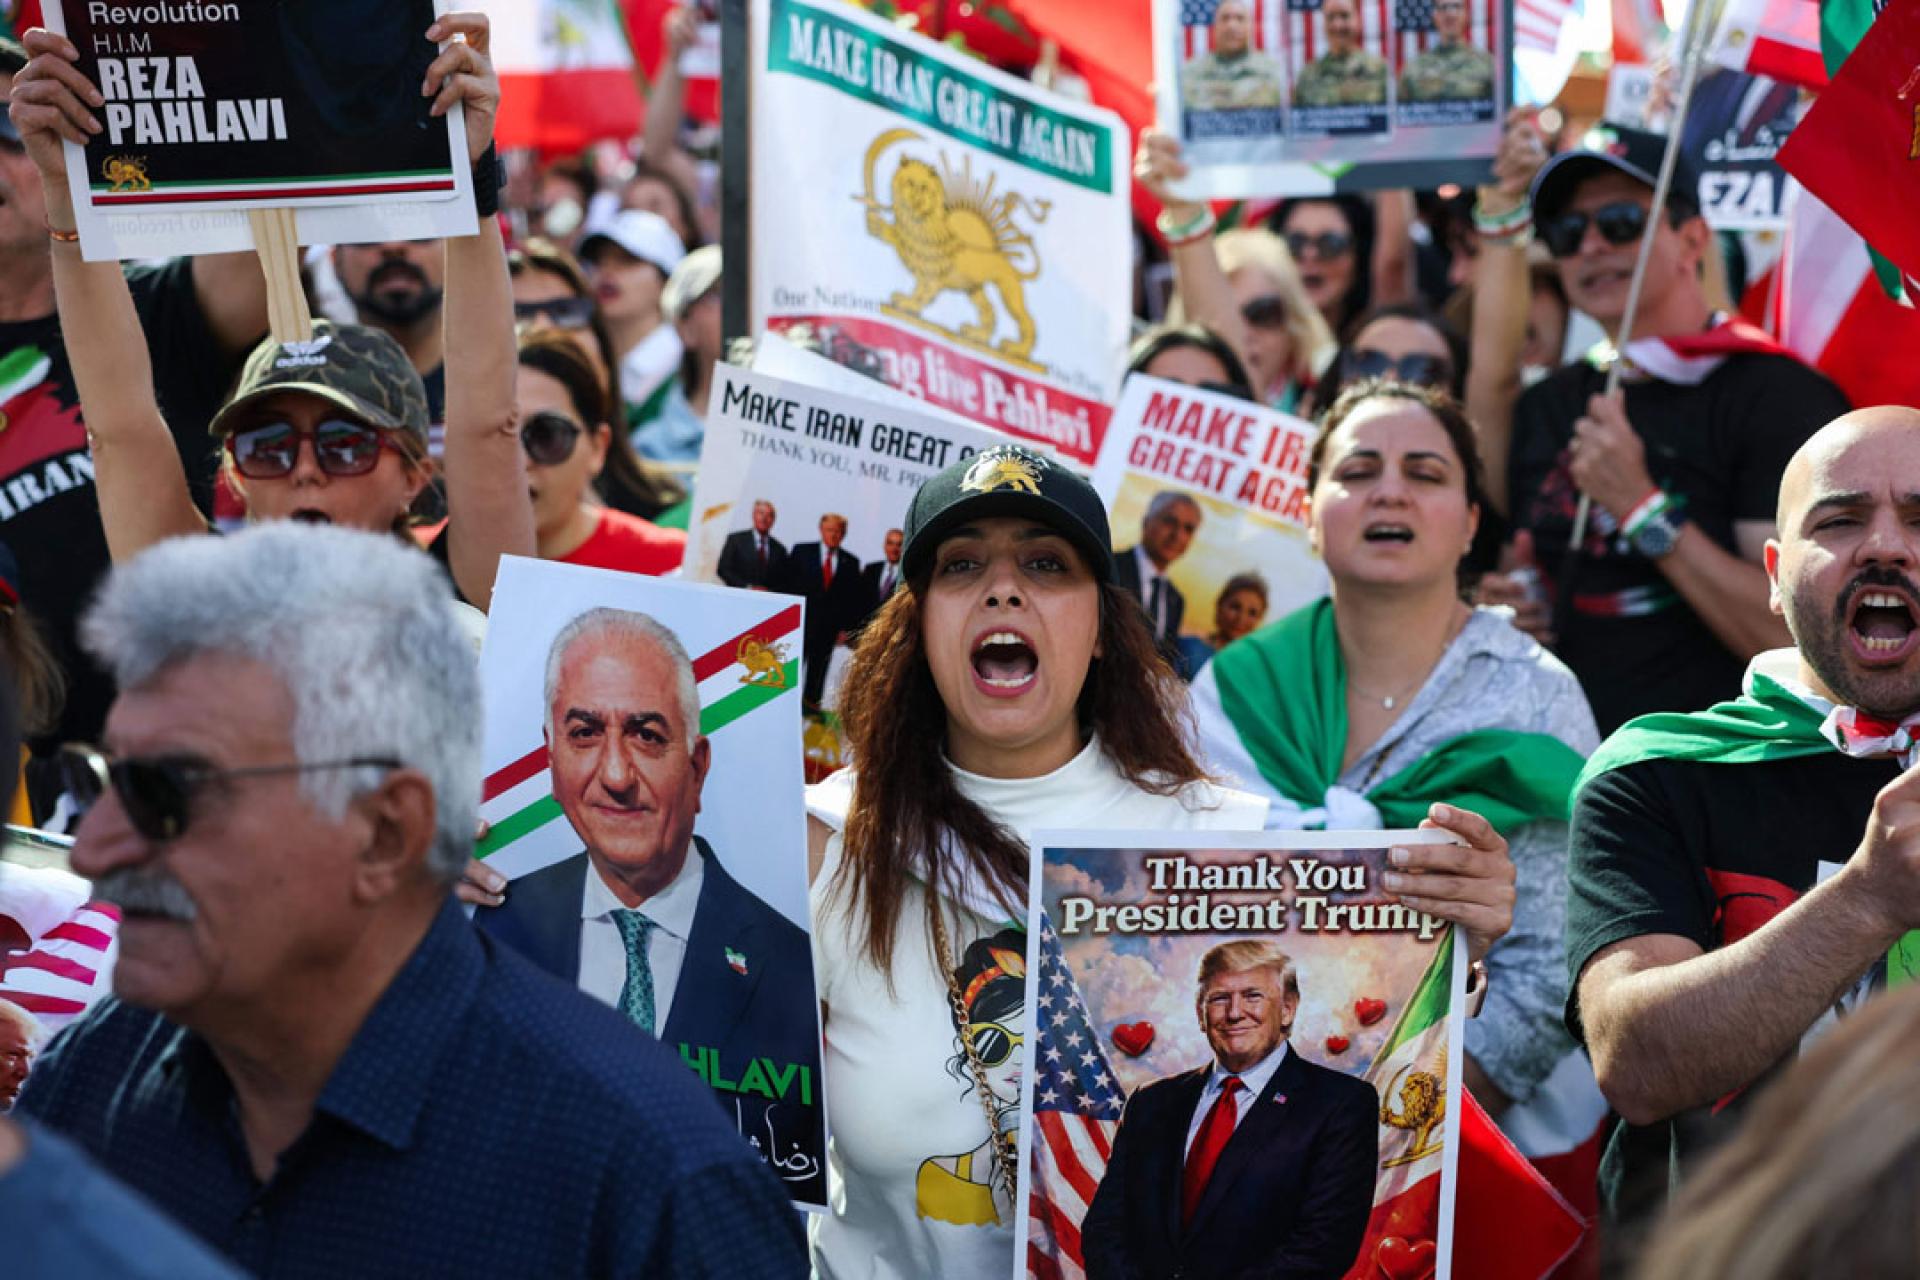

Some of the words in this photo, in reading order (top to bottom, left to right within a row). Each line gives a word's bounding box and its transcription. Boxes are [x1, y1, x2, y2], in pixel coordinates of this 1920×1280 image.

[88, 0, 240, 25] Revolution
[93, 32, 151, 53] H.I.M
[97, 55, 205, 100] REZA
[787, 13, 868, 86] MAKE
[871, 46, 934, 115] IRAN
[937, 76, 1016, 149] GREAT
[1019, 110, 1097, 177] AGAIN
[104, 98, 288, 145] PAHLAVI
[1697, 170, 1774, 219] EZA
[924, 346, 979, 412] live
[981, 370, 1093, 452] Pahlavi
[722, 379, 801, 432] MAKE
[804, 406, 864, 449] IRAN
[870, 423, 953, 468] GREAT
[1141, 391, 1259, 457] MAKE
[1261, 424, 1311, 480] IR
[739, 429, 804, 463] THANK
[809, 450, 853, 475] YOU,
[1128, 434, 1236, 494] GREAT
[1236, 468, 1309, 523] AGA
[1146, 857, 1284, 891] Thank
[1289, 858, 1366, 891] You
[1061, 895, 1284, 934] President
[1296, 895, 1446, 940] Trump
[678, 1043, 812, 1105] HLAVI
